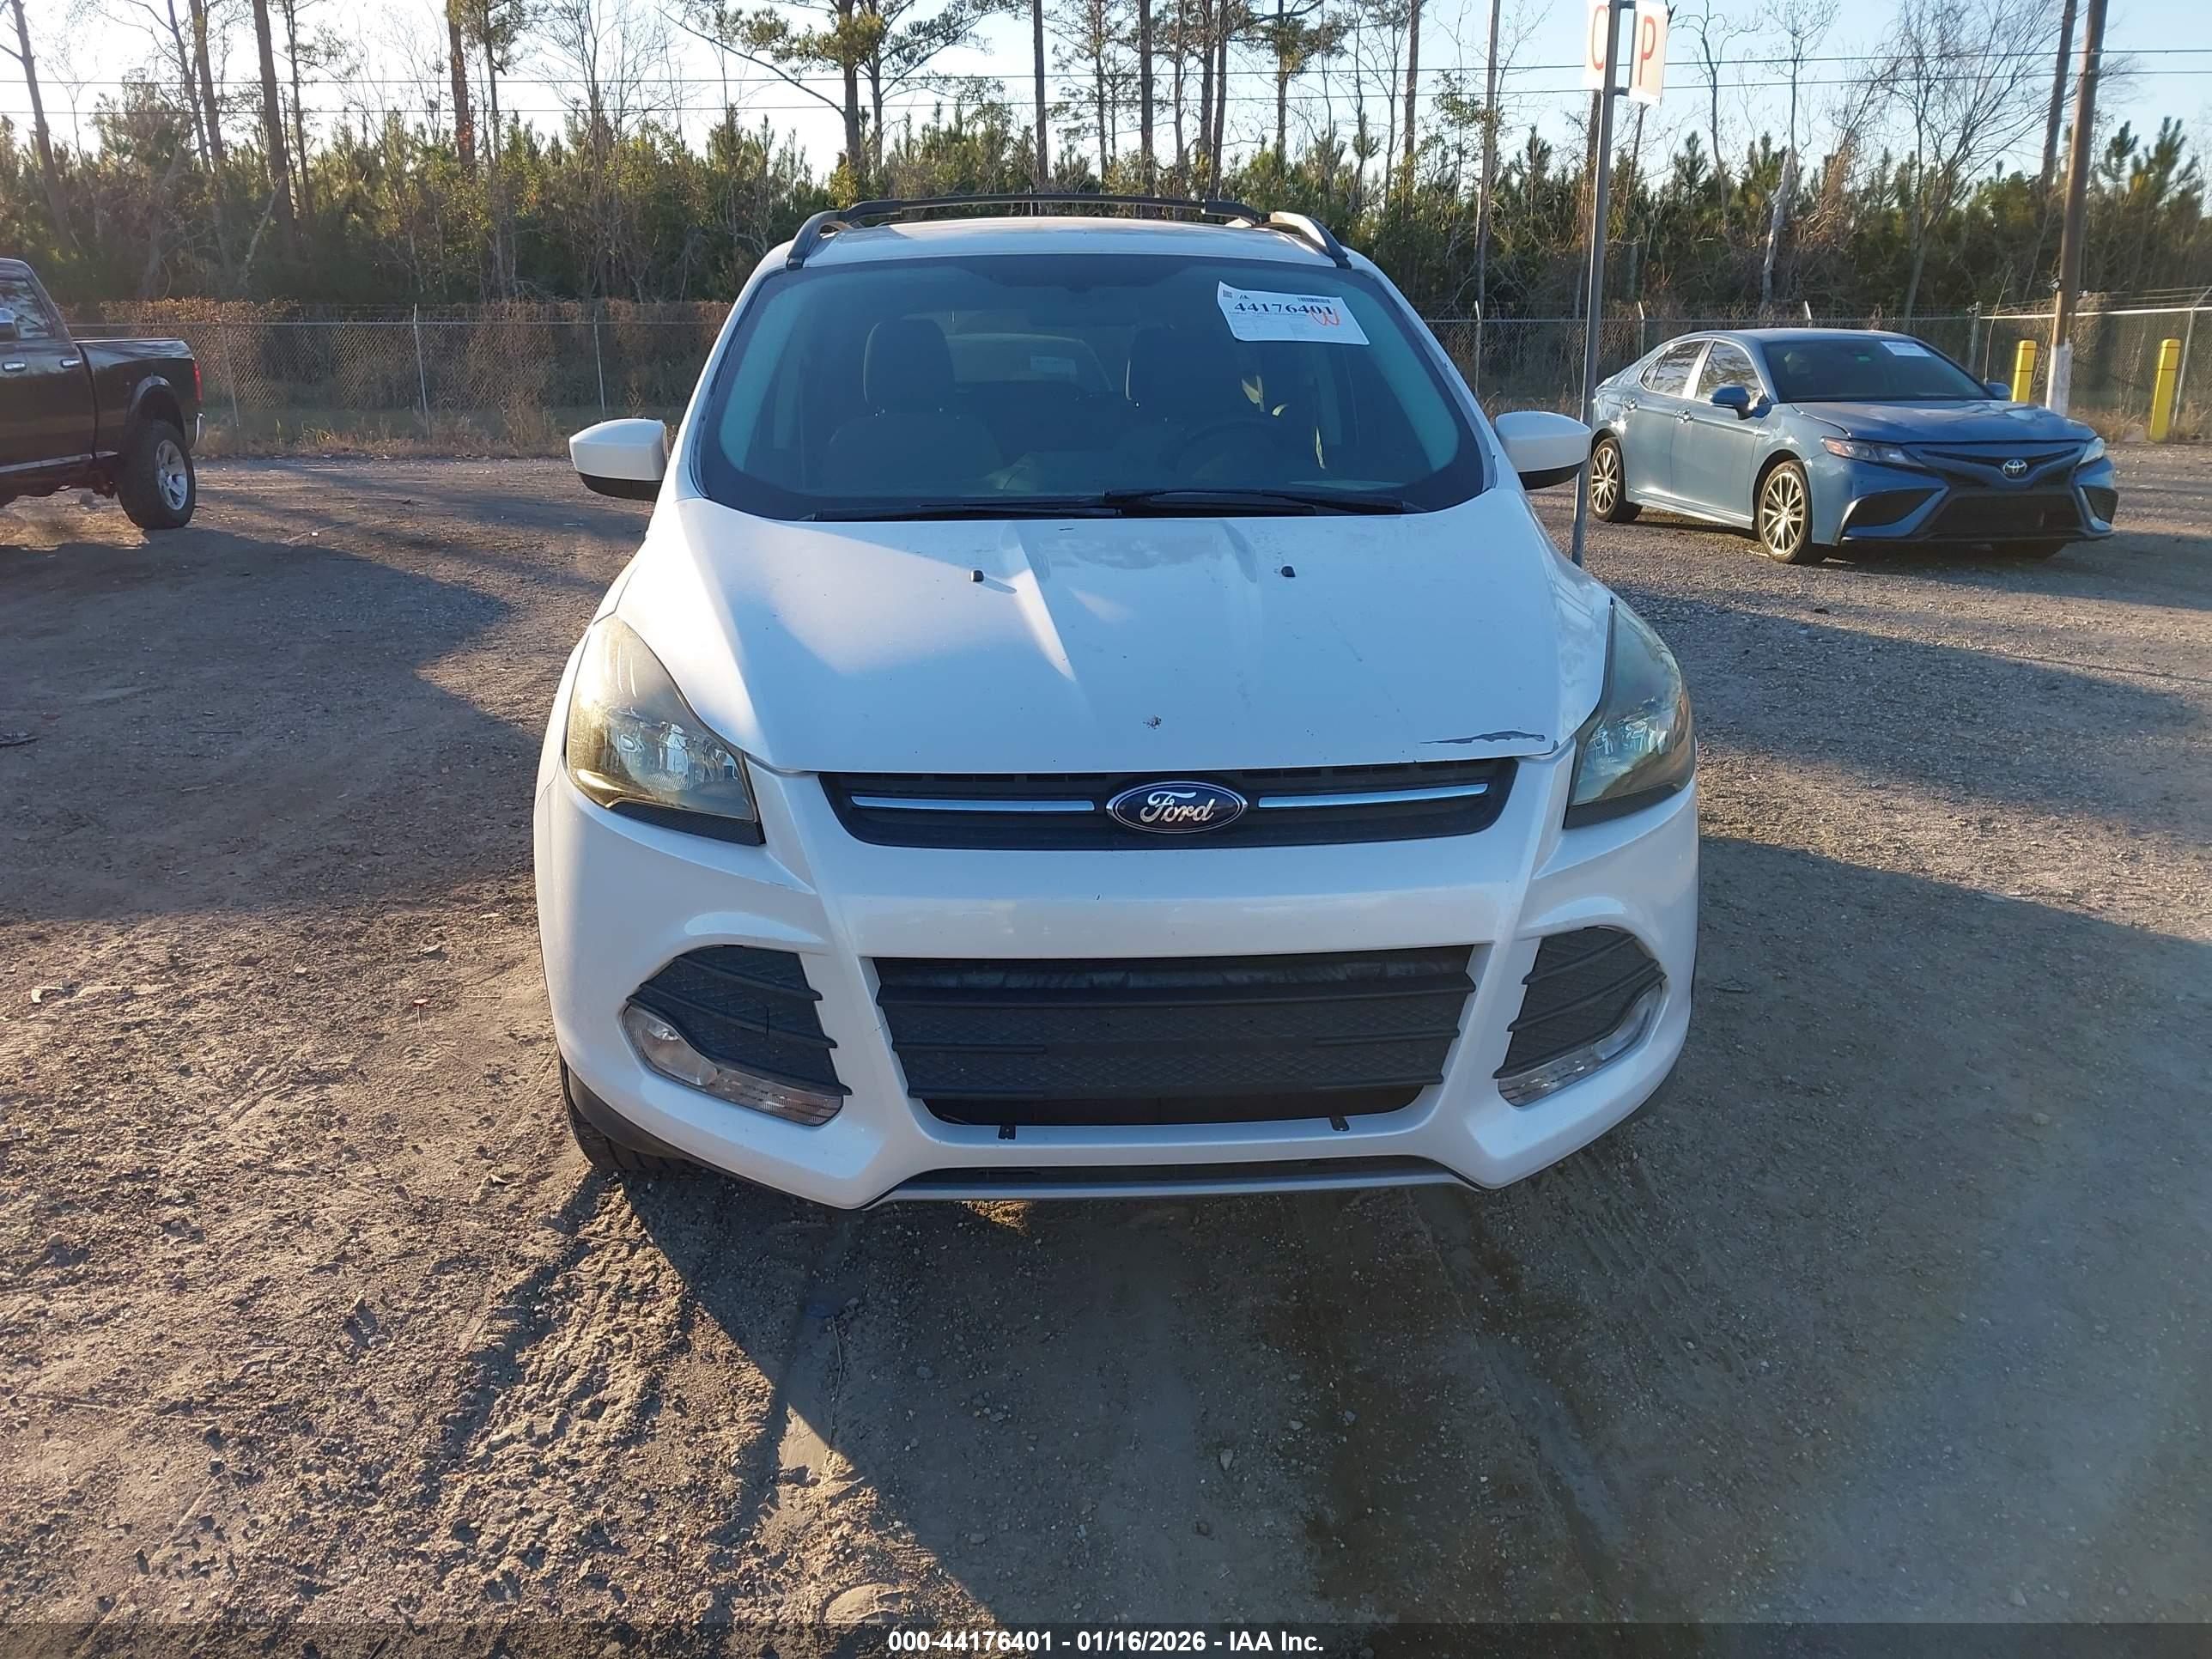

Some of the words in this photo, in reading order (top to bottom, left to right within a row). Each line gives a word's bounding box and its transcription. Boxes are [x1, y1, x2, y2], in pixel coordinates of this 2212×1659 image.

[1638, 15, 1656, 87] P
[1234, 302, 1334, 315] 44176401
[1139, 791, 1216, 823] Ford
